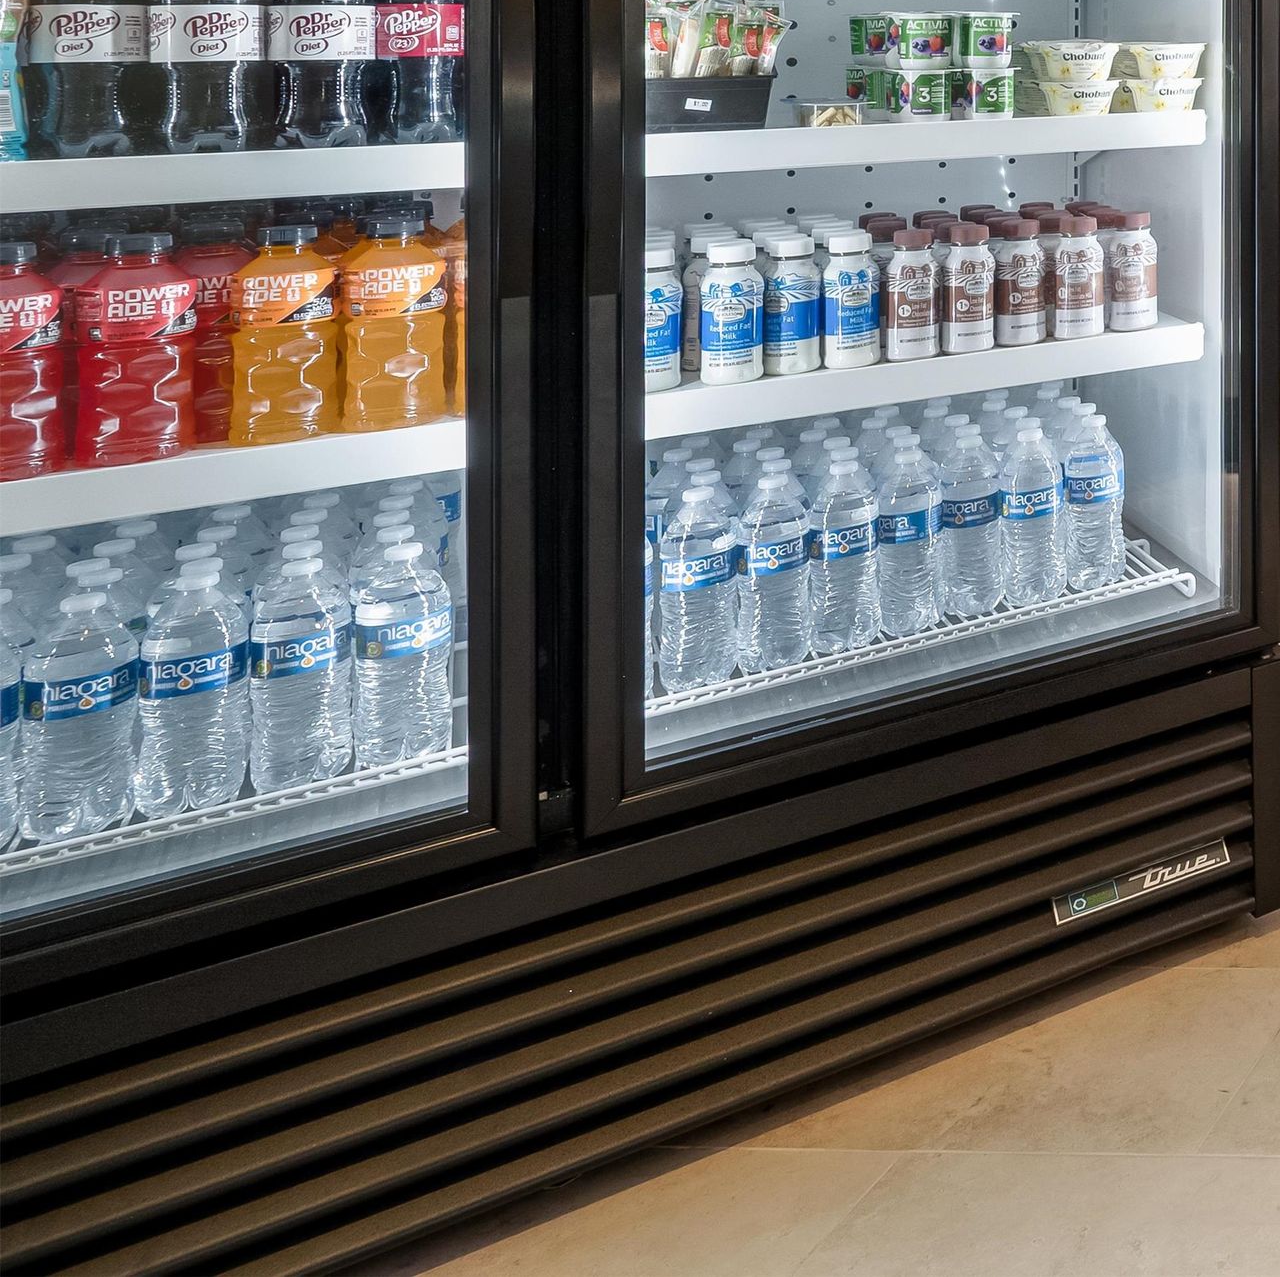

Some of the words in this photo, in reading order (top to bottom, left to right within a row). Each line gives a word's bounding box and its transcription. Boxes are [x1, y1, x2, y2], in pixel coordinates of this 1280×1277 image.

[73, 11, 98, 21] Dr
[207, 12, 233, 22] Dr
[310, 11, 335, 22] Dr
[54, 15, 116, 37] Pepper
[188, 17, 247, 38] Pepper
[290, 16, 348, 37] Pepper
[388, 16, 438, 36] Pepper
[906, 20, 949, 31] ACTIVIA
[61, 40, 86, 53] Diet
[196, 41, 220, 53] Diet
[299, 40, 321, 53] Diet
[395, 39, 408, 49] 23
[1062, 52, 1105, 61] Chobani
[918, 87, 931, 103] 3
[987, 87, 997, 102] 3
[364, 265, 435, 282] POWER
[243, 273, 318, 290] POWER
[364, 280, 404, 294] ADE
[108, 284, 189, 304] POWER
[242, 289, 282, 303] ADE
[108, 301, 157, 318] ADE
[782, 315, 794, 323] Fat
[709, 323, 738, 333] Reduced
[739, 322, 752, 331] Fat
[720, 332, 737, 341] Milk
[377, 612, 450, 643] niagara
[266, 630, 347, 663] niagara
[146, 650, 234, 684] niagara
[42, 668, 130, 701] niagara
[1128, 854, 1216, 889] True
